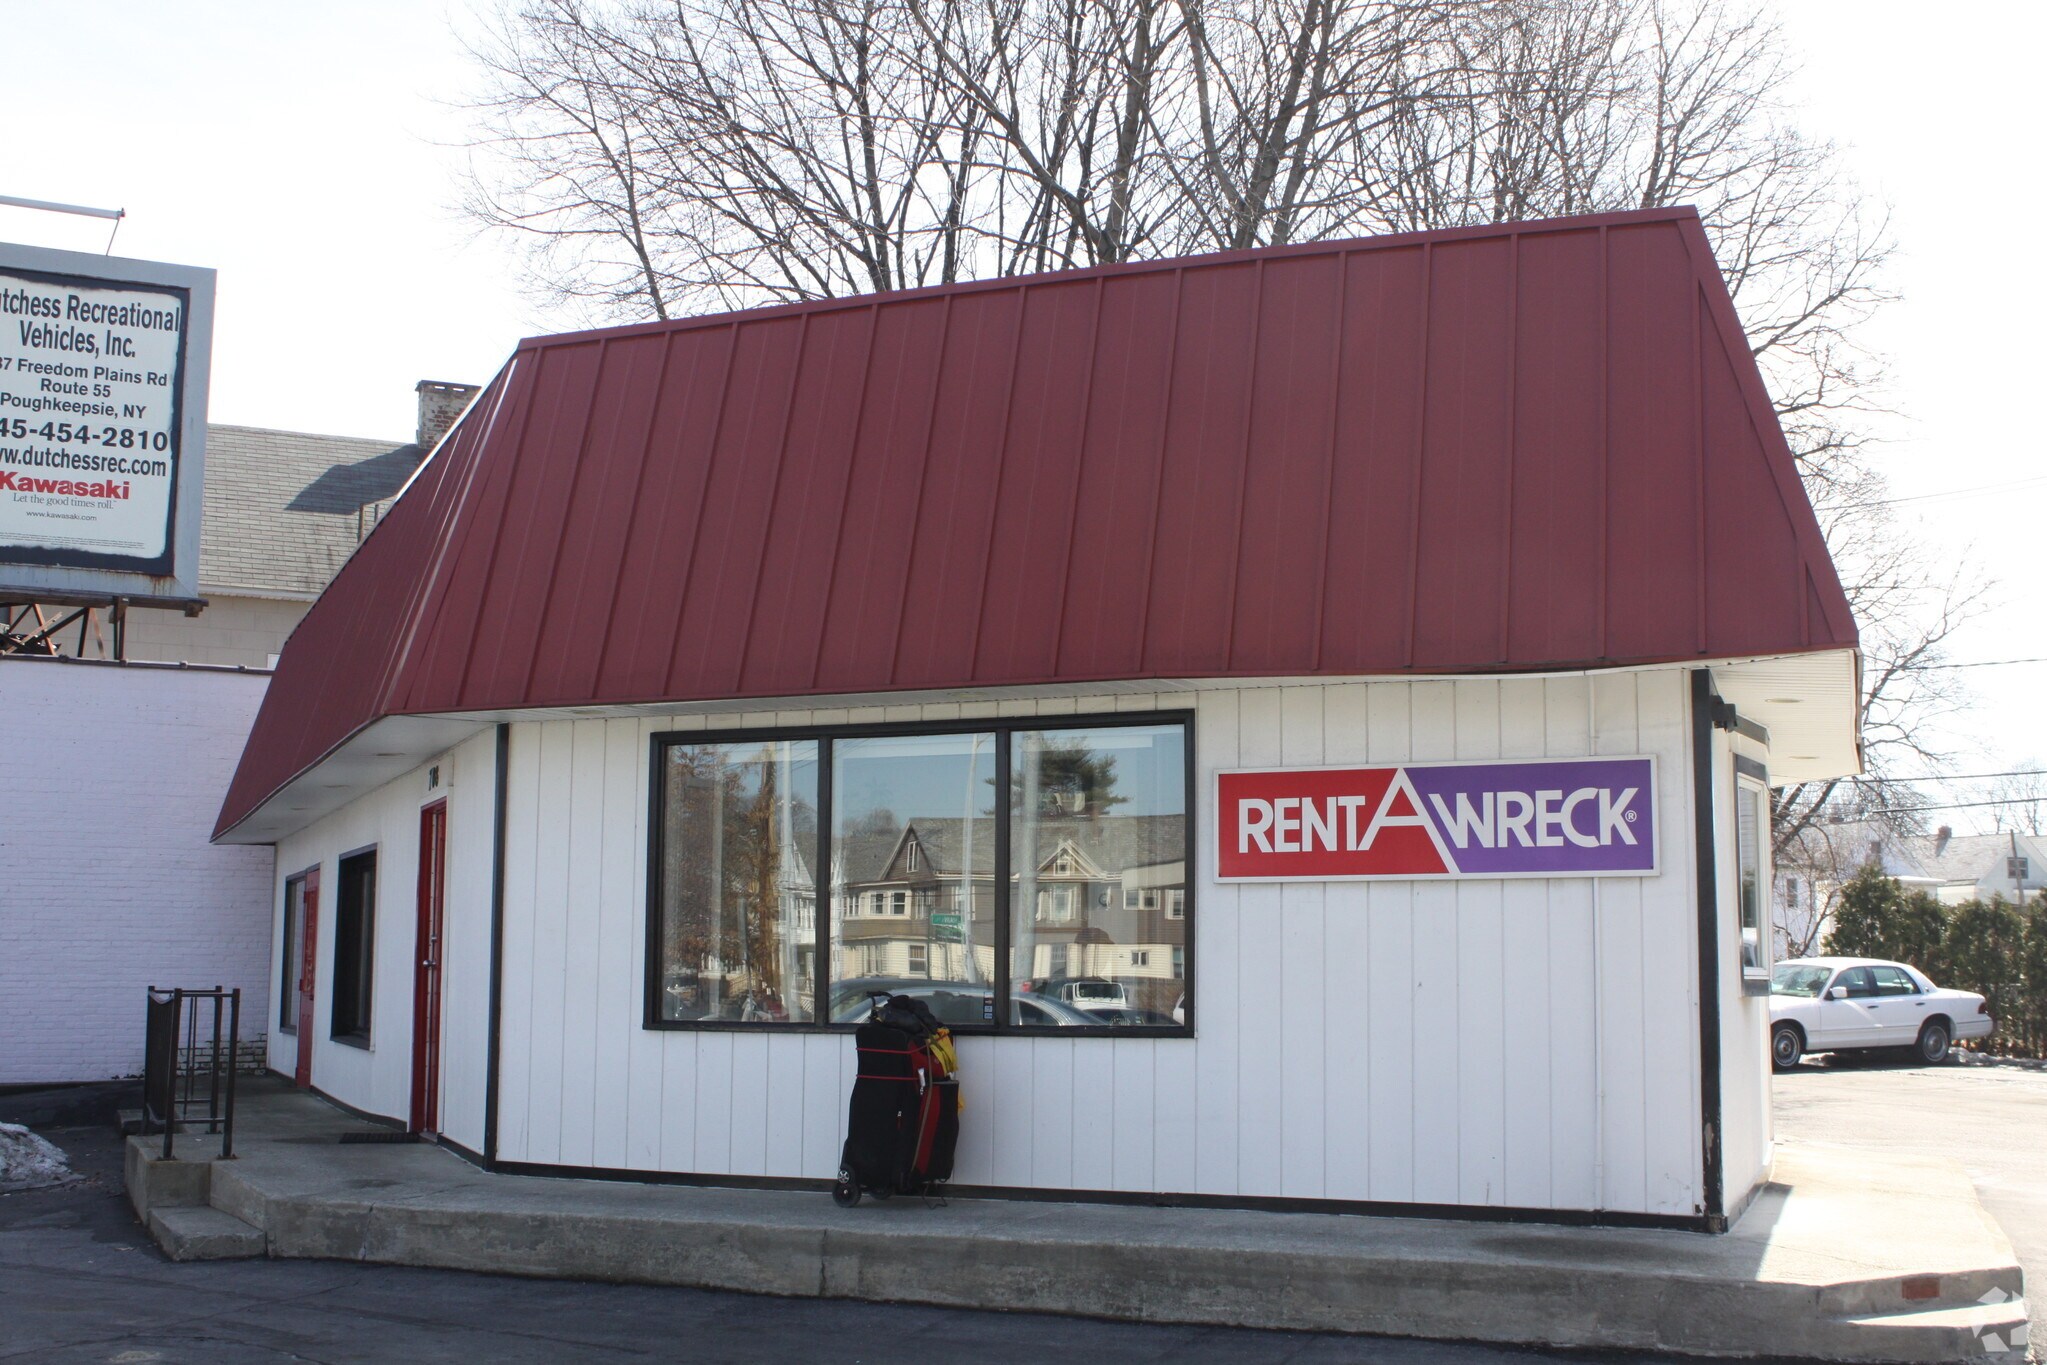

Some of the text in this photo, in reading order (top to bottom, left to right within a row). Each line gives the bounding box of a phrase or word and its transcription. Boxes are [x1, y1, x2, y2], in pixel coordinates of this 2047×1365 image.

[0, 287, 180, 332] tchess Recreational
[20, 320, 136, 359] Vehicles, Inc.
[18, 358, 88, 378] Freedom
[94, 366, 142, 384] Plains
[147, 372, 167, 387] Rd
[41, 378, 111, 398] Route 55
[0, 392, 147, 419] Poughkeepsie, NY
[0, 417, 168, 451] 45-454-2810
[0, 445, 166, 477] w.dutchessrec.com
[0, 470, 130, 499] Kawasaki
[13, 493, 27, 503] Let
[30, 494, 45, 504] the
[46, 496, 69, 506] good
[71, 498, 95, 508] times
[26, 511, 97, 521] www.kawasaki.com
[1238, 795, 1366, 853] RENT
[1356, 768, 1461, 874] A
